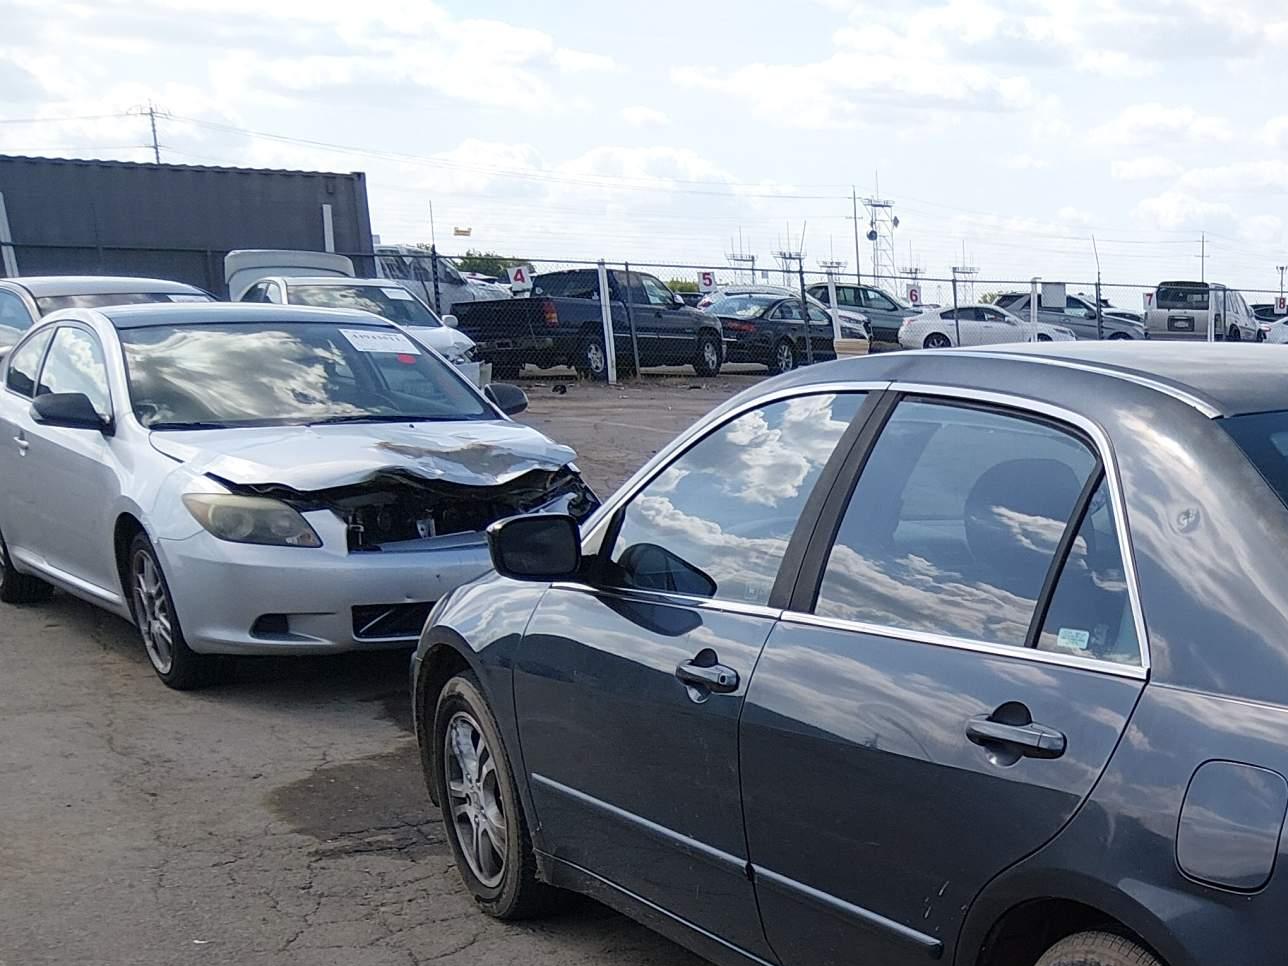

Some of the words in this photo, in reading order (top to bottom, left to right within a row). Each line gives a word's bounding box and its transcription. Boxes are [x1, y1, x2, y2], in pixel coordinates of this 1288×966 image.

[513, 268, 525, 283] 4
[702, 271, 713, 287] 5
[909, 288, 919, 303] 6
[1145, 292, 1154, 306] 7
